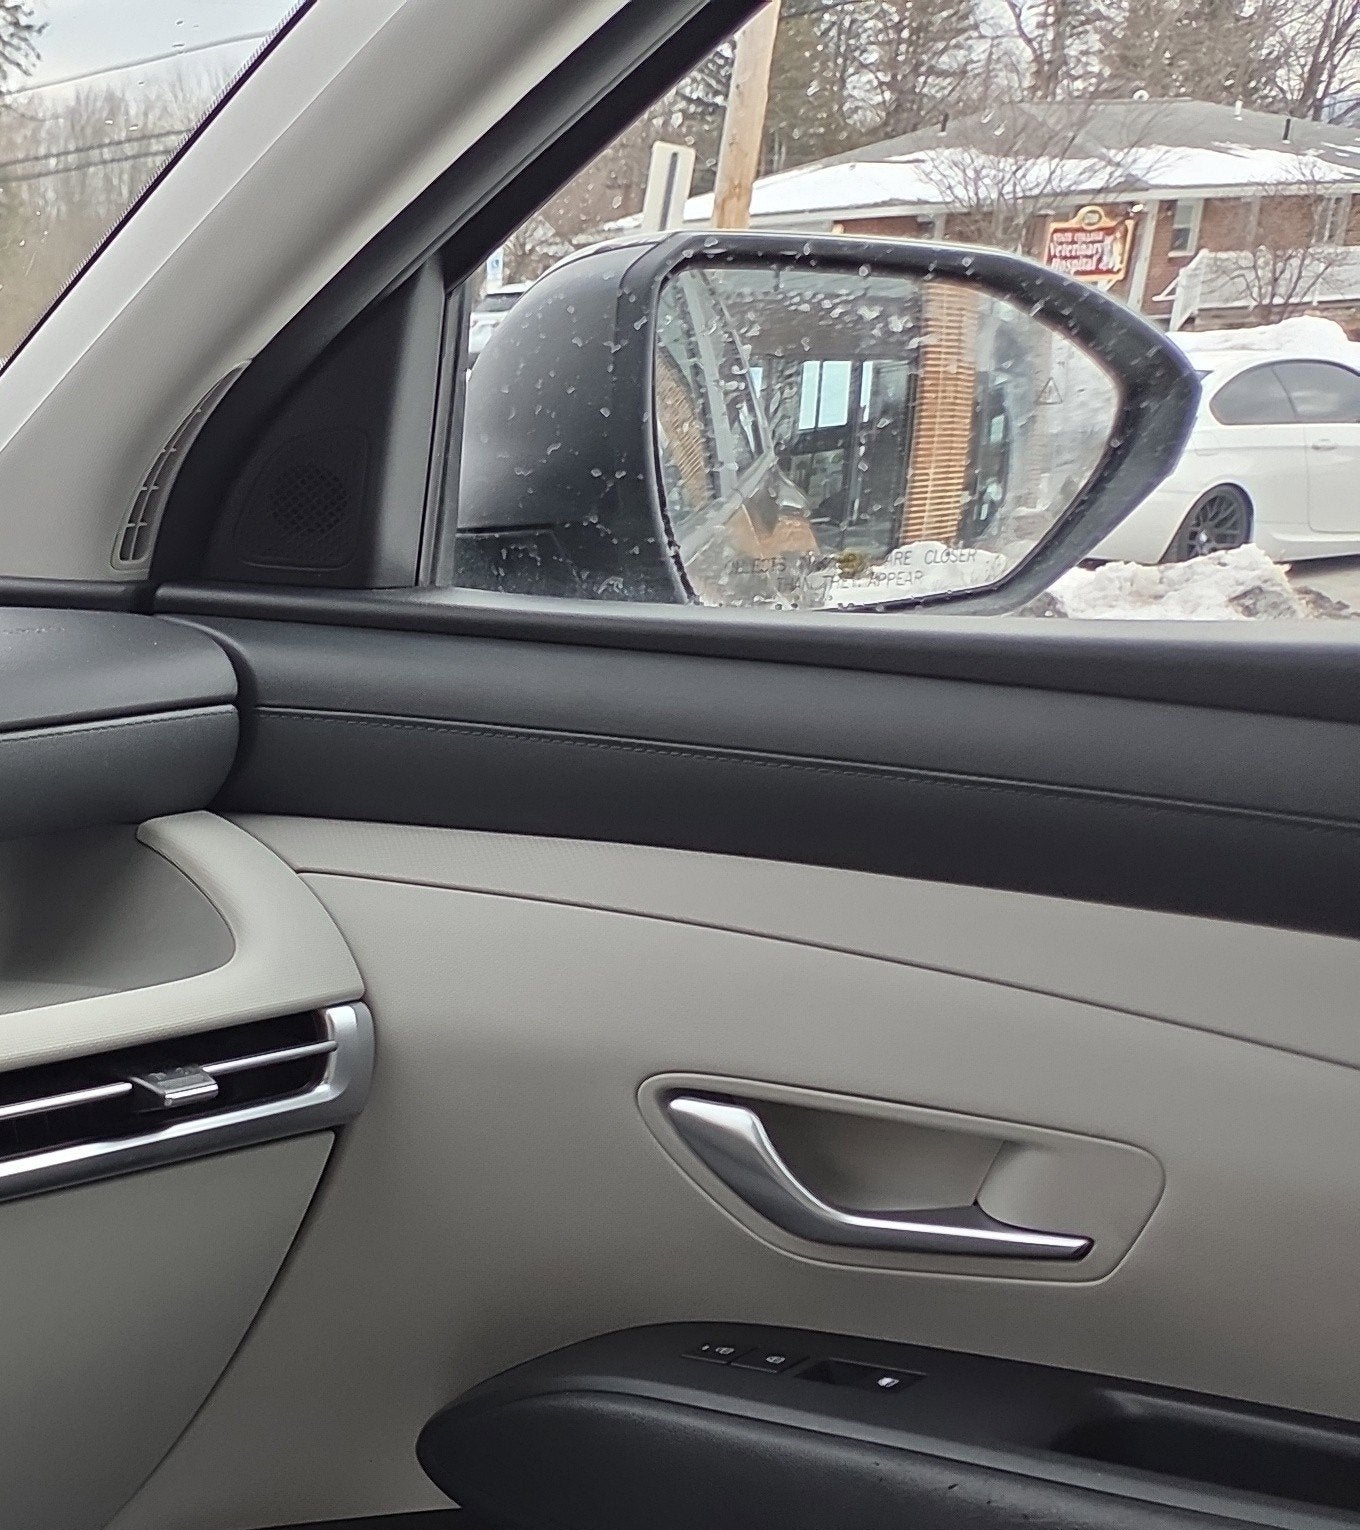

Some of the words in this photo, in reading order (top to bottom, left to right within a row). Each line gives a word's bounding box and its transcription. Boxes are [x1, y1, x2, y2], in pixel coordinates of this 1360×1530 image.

[885, 550, 912, 566] ARE
[924, 548, 977, 565] CLOSER
[867, 570, 924, 587] APPEAR
